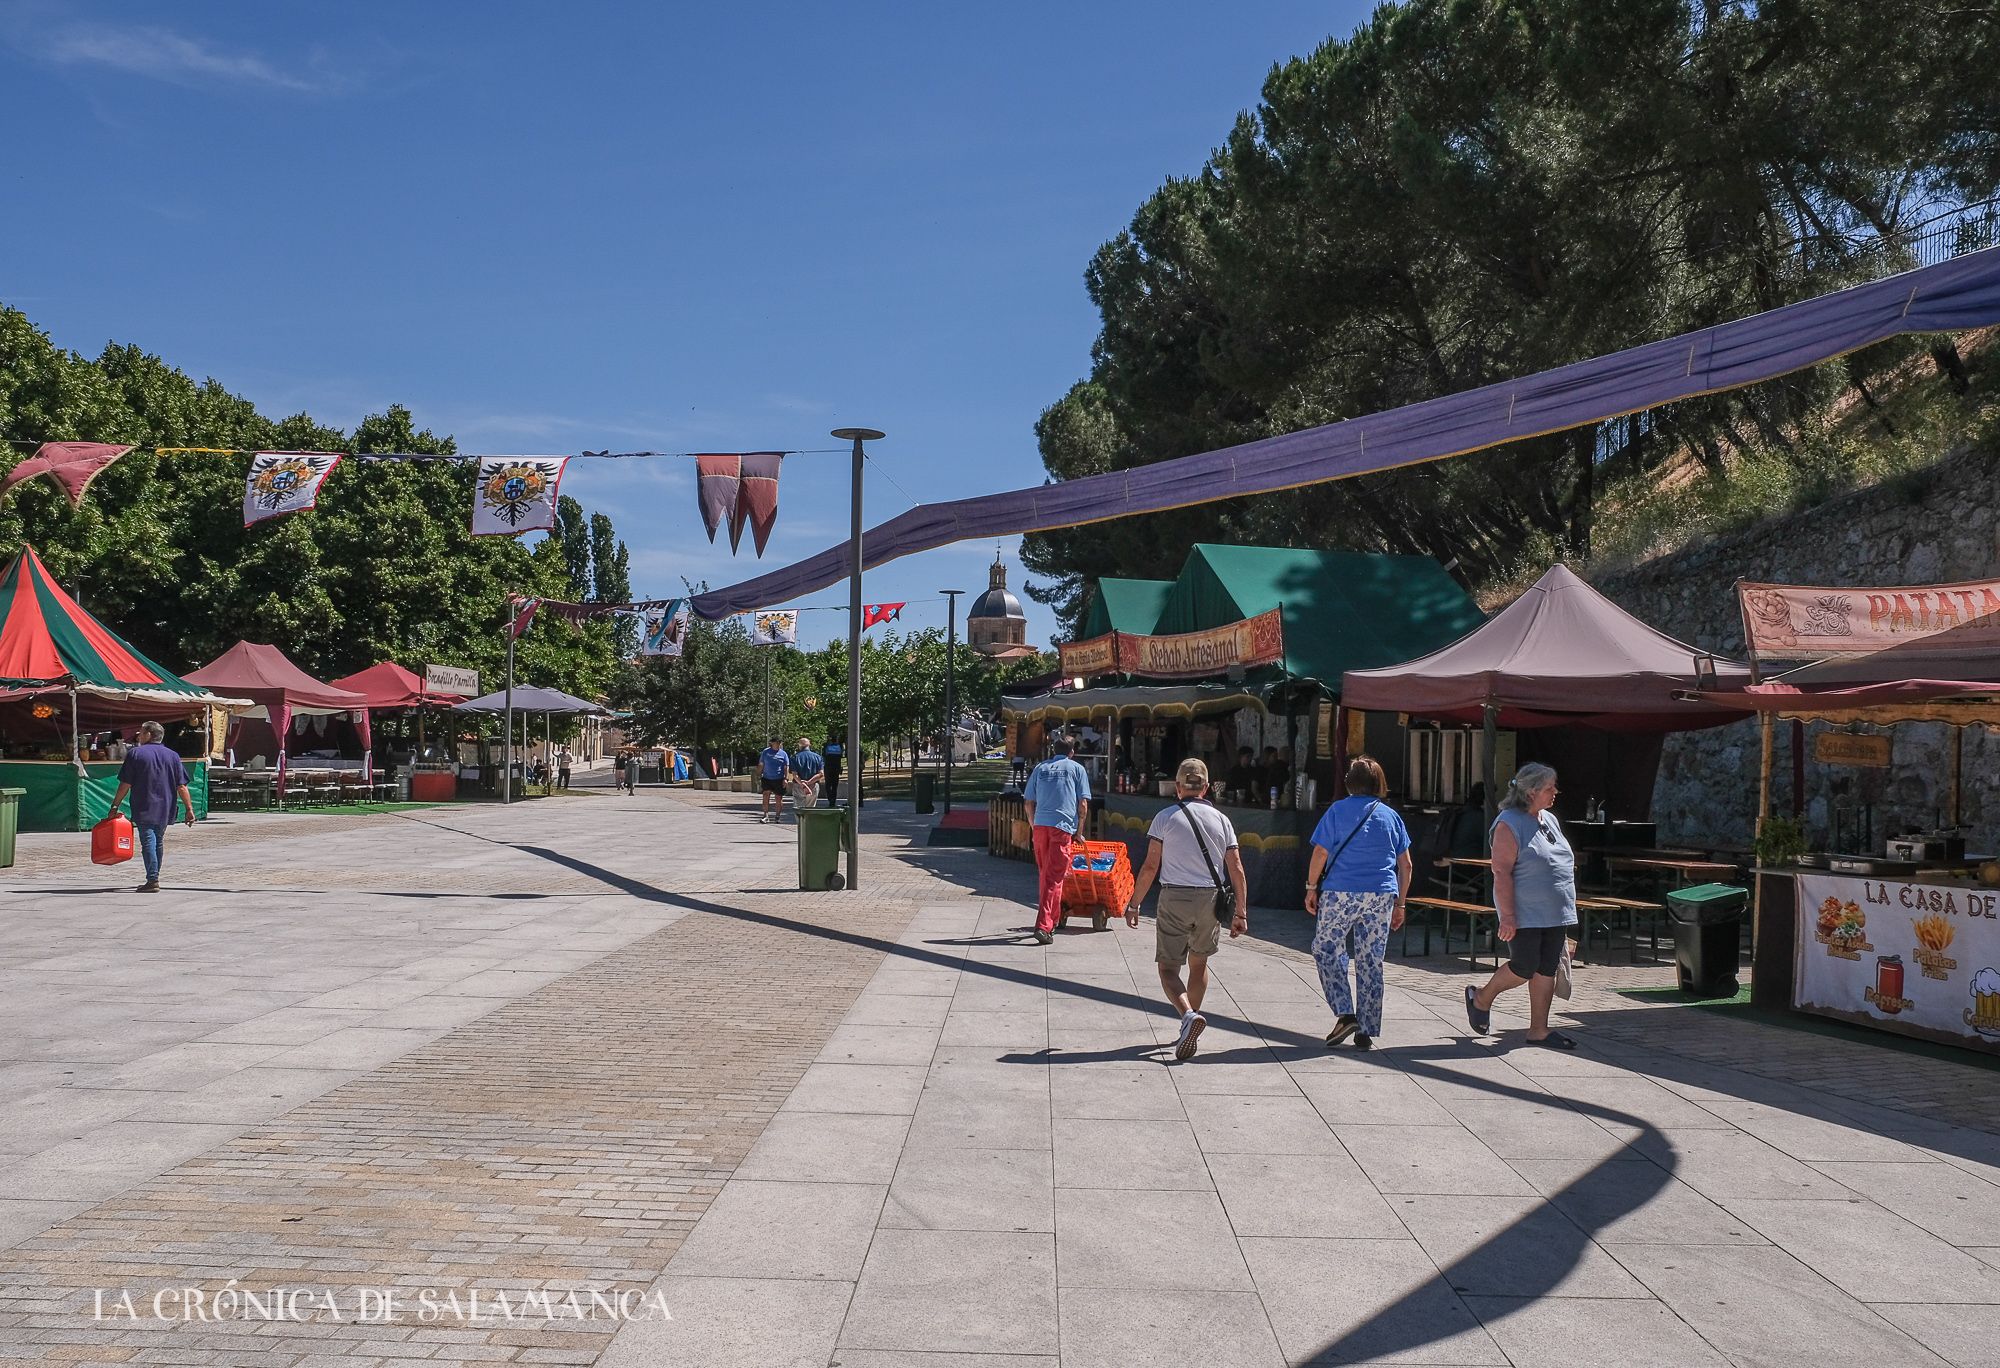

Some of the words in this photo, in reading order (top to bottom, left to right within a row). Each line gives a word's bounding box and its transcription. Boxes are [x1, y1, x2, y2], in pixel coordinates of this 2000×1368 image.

[1149, 639, 1181, 669] Kebab
[1183, 628, 1239, 668] Artesanal
[1864, 881, 1891, 906] LA
[1899, 884, 1958, 915] CASA
[1967, 893, 1997, 919] DE
[1912, 948, 1957, 970] Patatas
